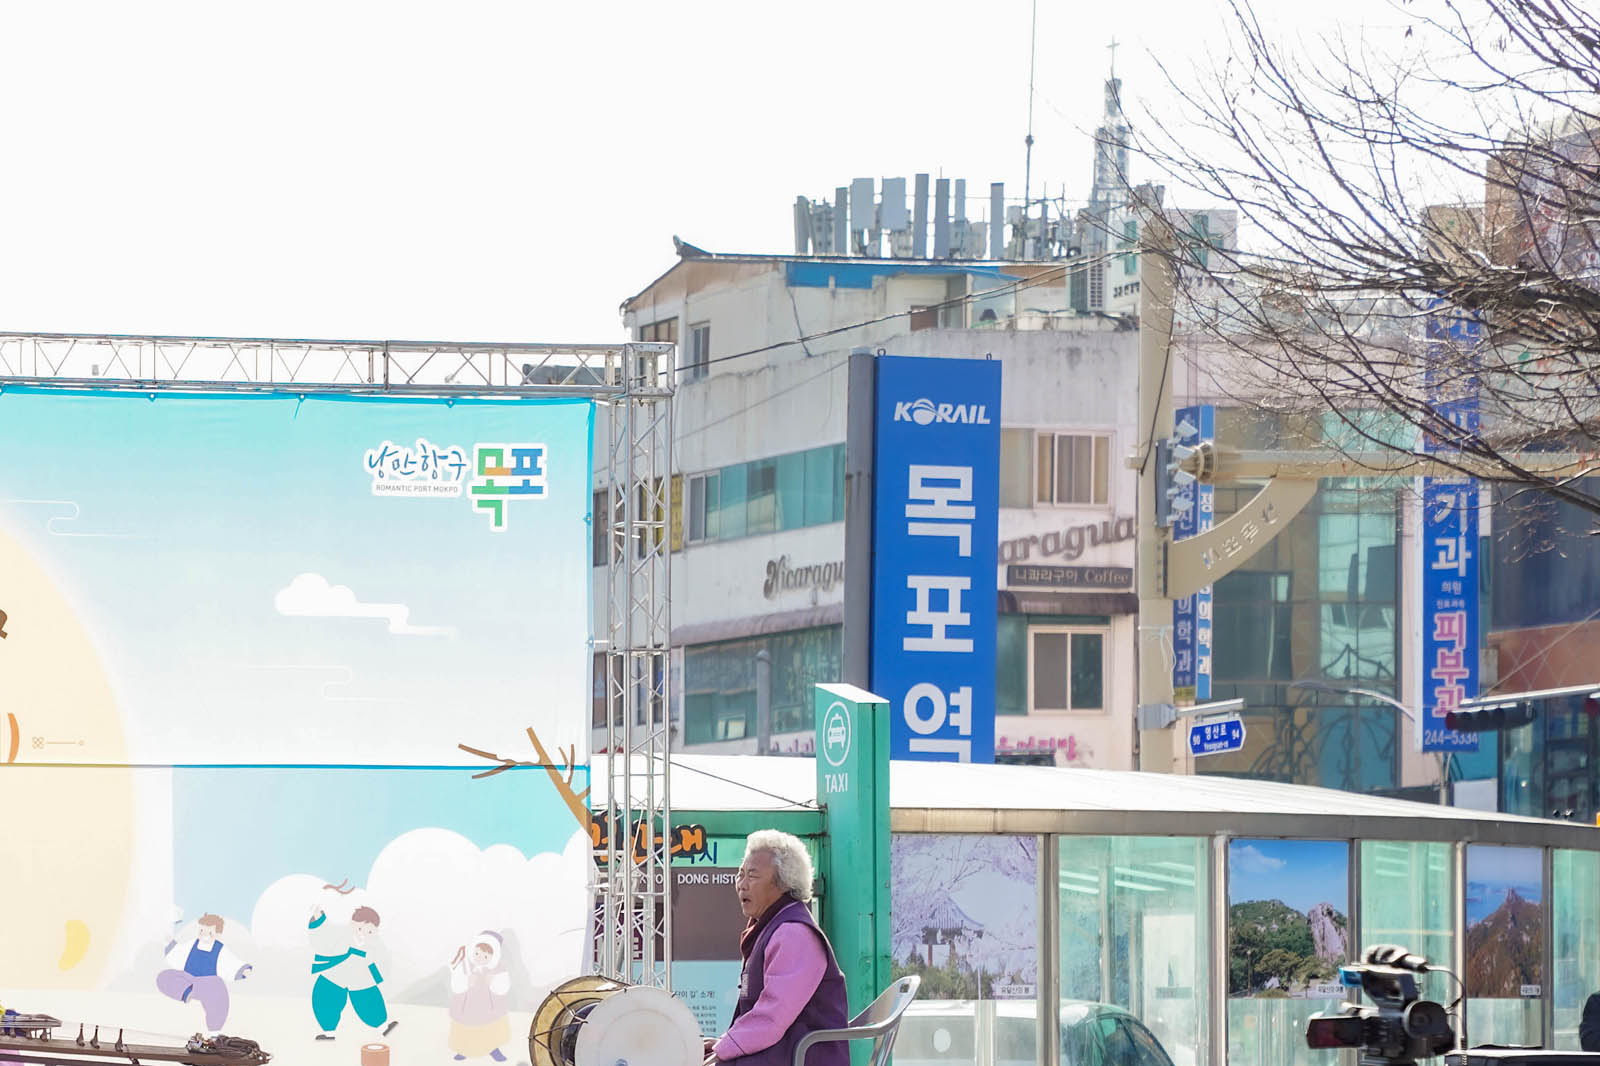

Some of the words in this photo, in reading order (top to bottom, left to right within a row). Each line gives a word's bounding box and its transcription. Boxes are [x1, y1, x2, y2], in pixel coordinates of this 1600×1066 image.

[893, 398, 991, 425] KORAIL
[367, 443, 467, 481] 낭만항구
[413, 484, 433, 494] PORT
[471, 448, 544, 527] 목포
[1084, 569, 1129, 585] Coffee
[902, 463, 977, 764] 목포역
[1192, 734, 1201, 746] 90
[1231, 728, 1240, 740] 94
[824, 773, 849, 793] TAXI
[677, 873, 709, 885] DONG
